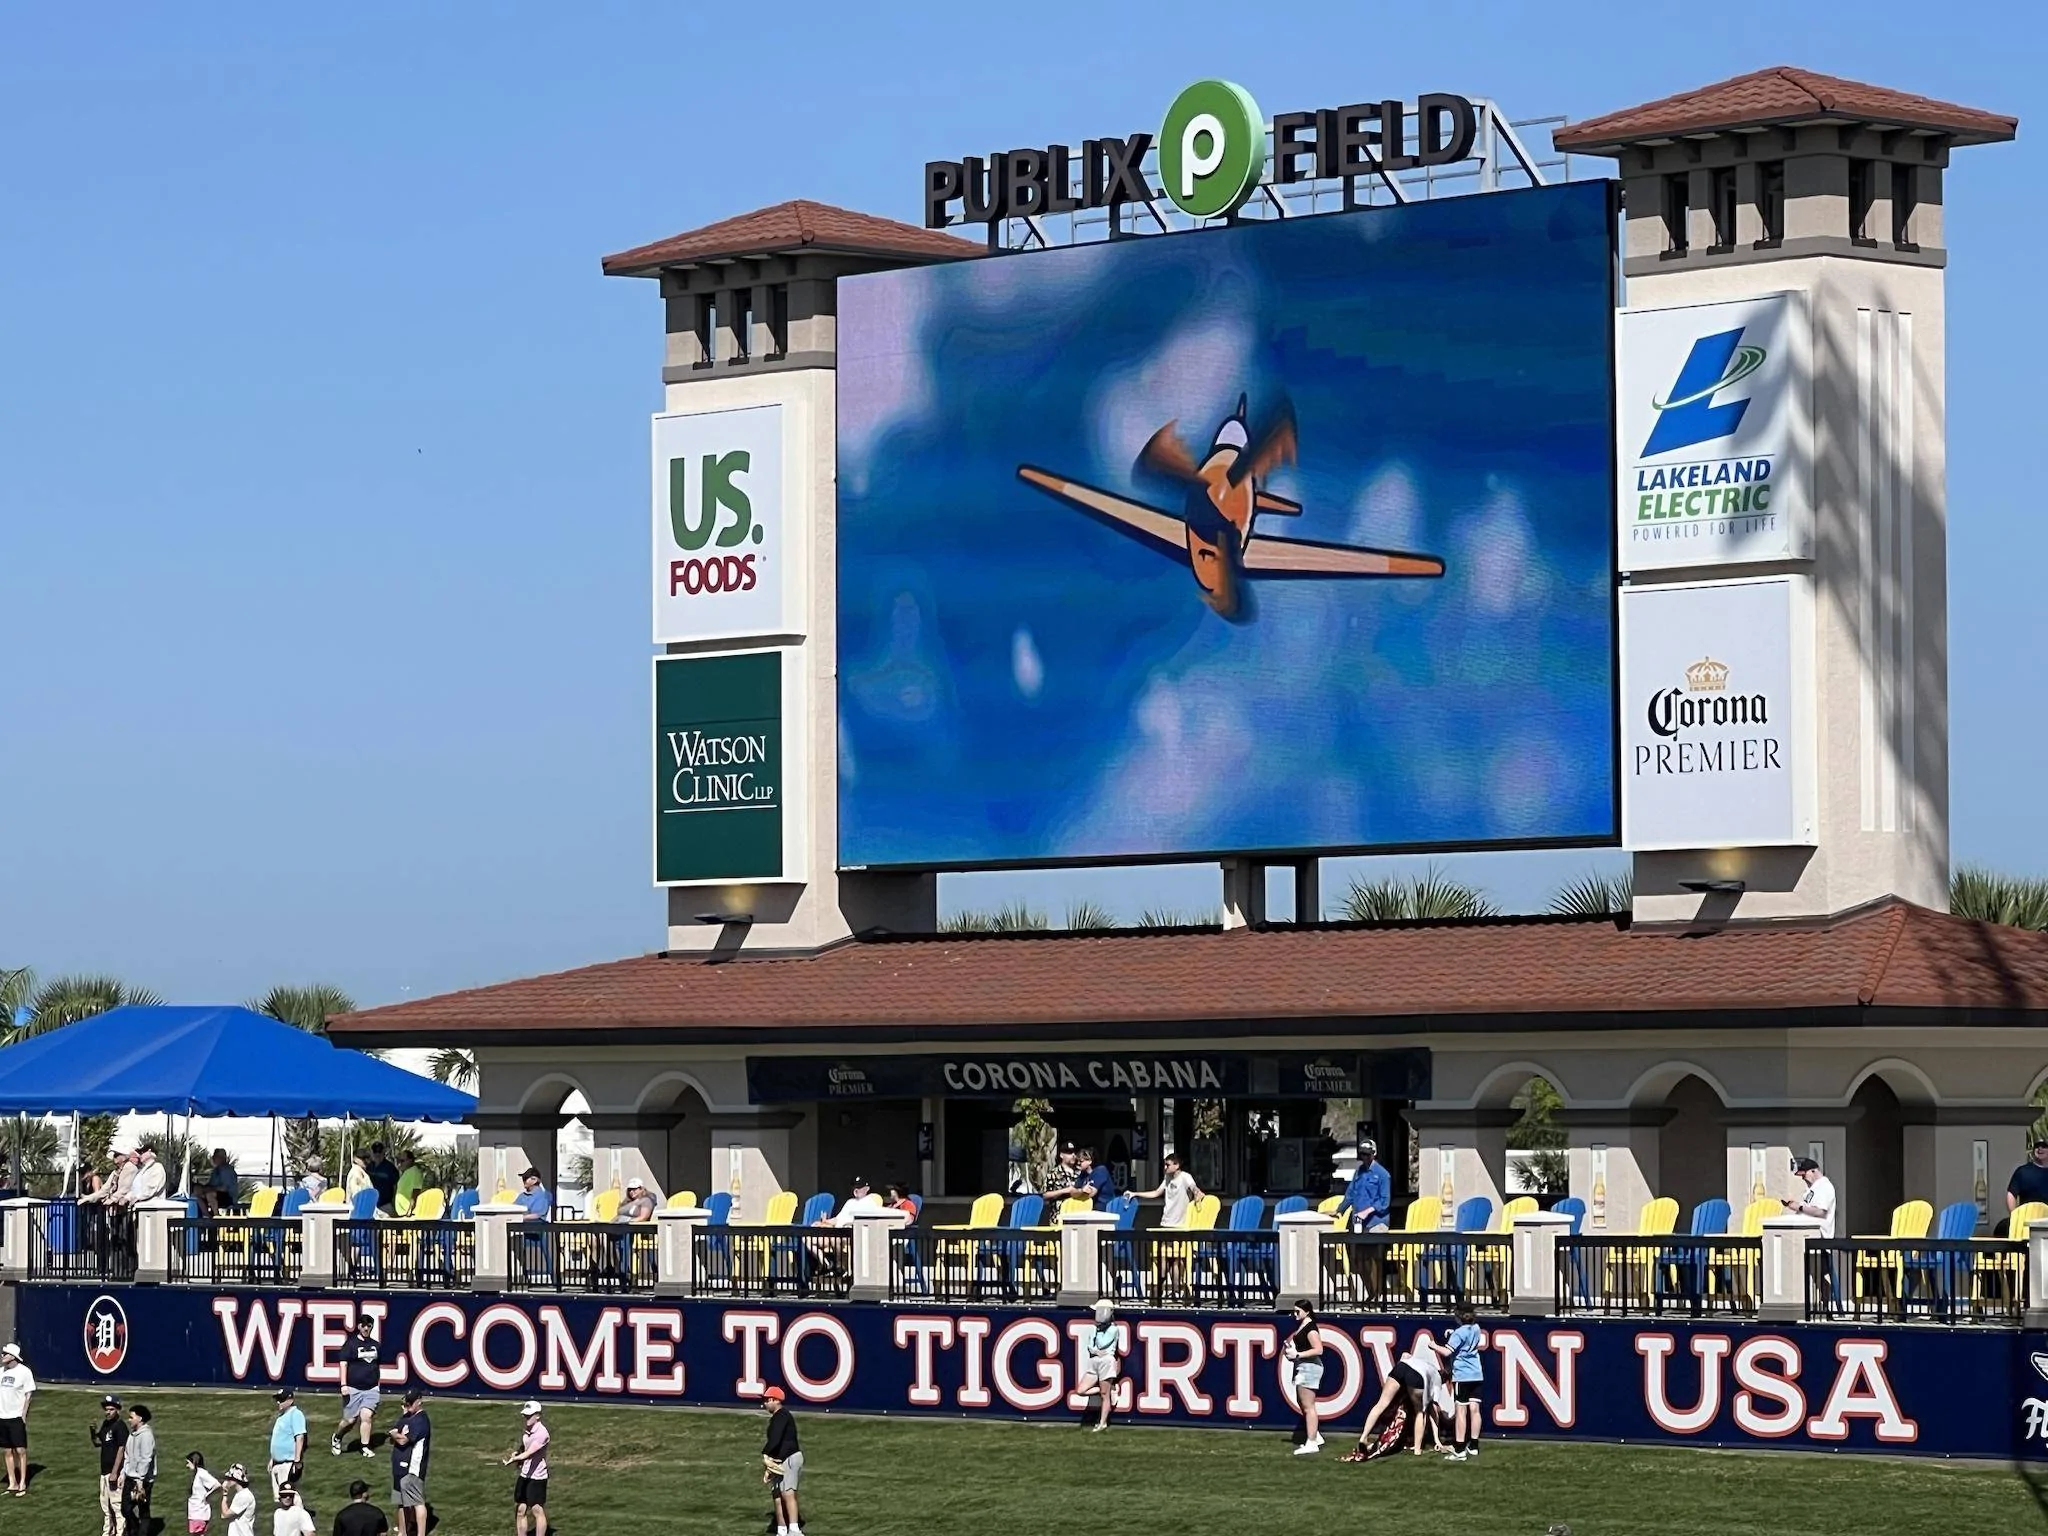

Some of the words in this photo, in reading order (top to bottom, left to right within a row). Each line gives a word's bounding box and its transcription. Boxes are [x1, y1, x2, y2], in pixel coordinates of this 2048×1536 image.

[925, 133, 1161, 228] PUBLIX
[1273, 93, 1477, 184] FIELD
[1637, 459, 1771, 491] LAKELAND
[1638, 484, 1770, 521] ELECTRIC
[1633, 520, 1699, 541] POWERED
[1710, 519, 1735, 536] FOR
[1746, 517, 1776, 533] LIFE
[670, 554, 757, 597] FOODS
[1647, 687, 1768, 742] Corona
[667, 731, 767, 767] WATSON
[1635, 738, 1781, 776] PREMIER
[672, 768, 754, 804] CLINIC
[755, 786, 774, 800] LLP
[828, 1082, 875, 1096] PREMIER
[944, 1061, 1081, 1091] CORONA
[1088, 1060, 1221, 1088] CABANA
[1304, 1079, 1353, 1093] PREMIER
[212, 1297, 685, 1395] WELCOME
[722, 1310, 855, 1402] TO
[1635, 1332, 1919, 1442] USA
